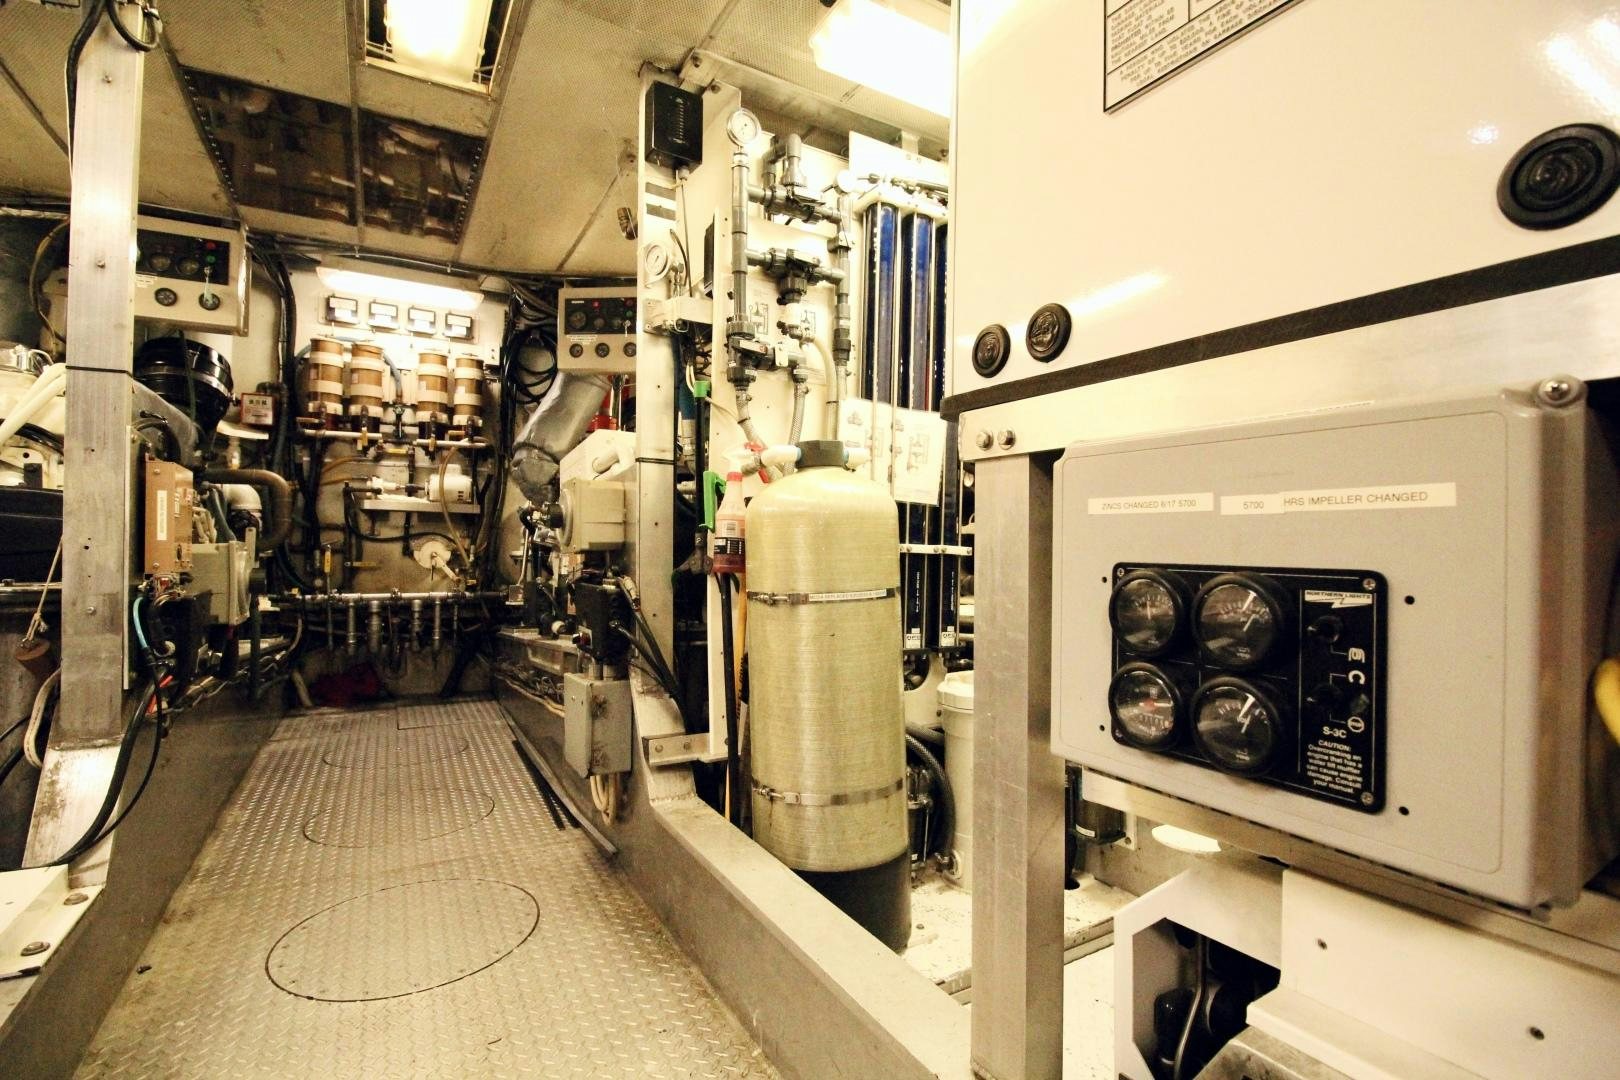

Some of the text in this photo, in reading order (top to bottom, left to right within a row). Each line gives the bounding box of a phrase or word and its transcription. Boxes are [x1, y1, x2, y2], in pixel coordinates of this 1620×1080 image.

[1243, 500, 1264, 510] 5700
[1308, 494, 1362, 505] IMPELLER
[1366, 491, 1428, 503] CHANGED
[1322, 726, 1347, 739] S-3C
